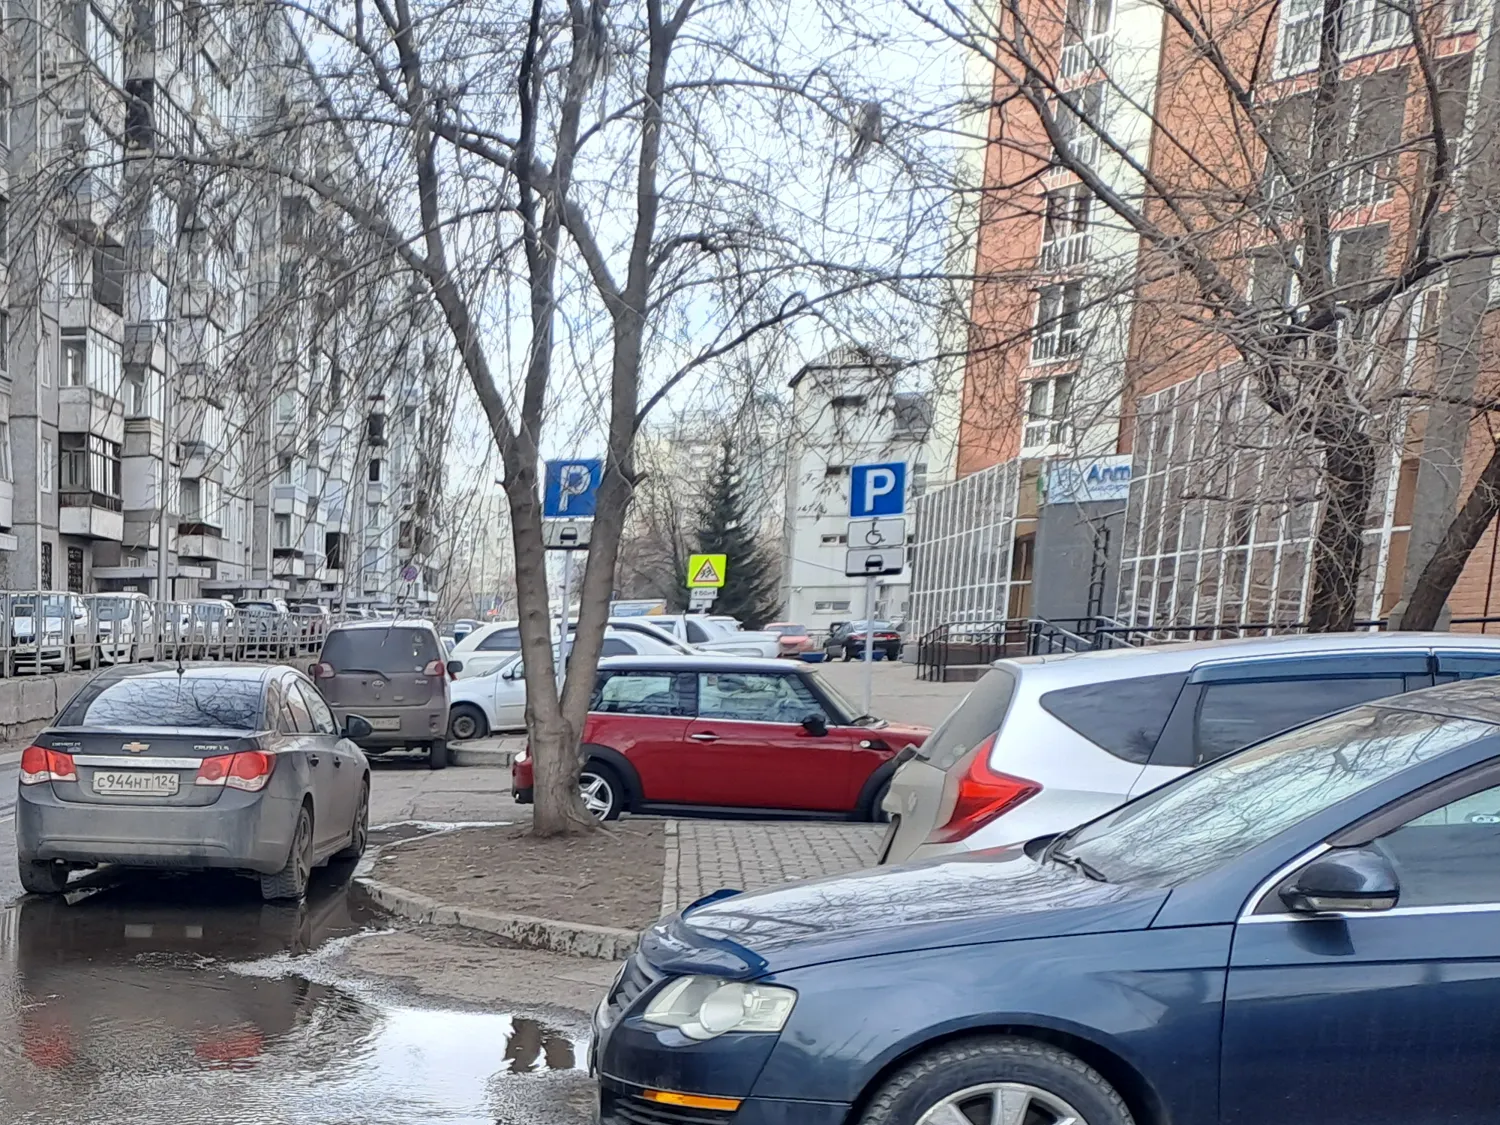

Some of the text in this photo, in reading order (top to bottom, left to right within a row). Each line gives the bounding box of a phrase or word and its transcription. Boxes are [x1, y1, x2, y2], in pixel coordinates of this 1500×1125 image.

[559, 465, 592, 512] P
[864, 468, 896, 512] P
[97, 774, 176, 789] С944НТ 124
